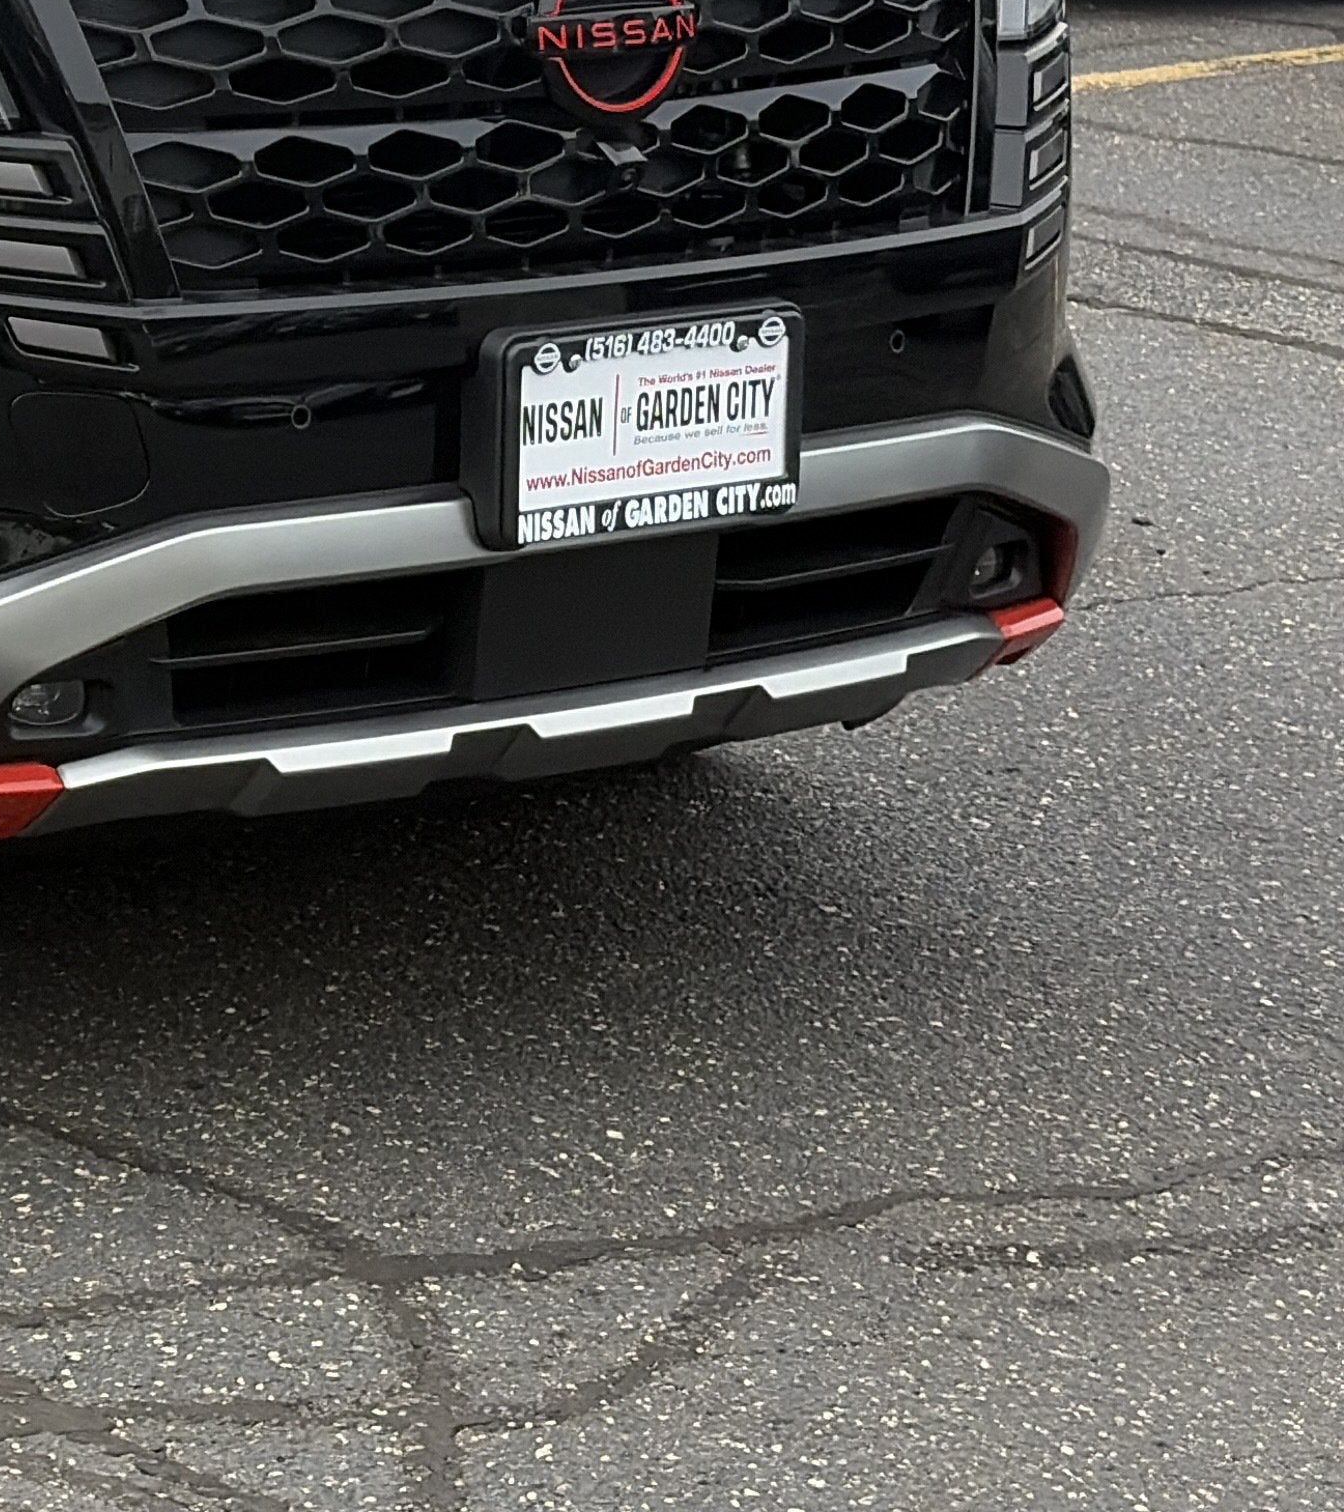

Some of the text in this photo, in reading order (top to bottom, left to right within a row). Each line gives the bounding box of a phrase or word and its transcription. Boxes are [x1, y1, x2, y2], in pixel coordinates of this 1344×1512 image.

[537, 12, 696, 51] NISSAN
[584, 321, 736, 362] (516) 483-4400
[638, 363, 776, 387] The World's #1 Nissan Dealer
[522, 377, 776, 446] NISSAN OF GARDEN CITY
[634, 432, 681, 445] Because
[684, 430, 701, 439] we
[704, 425, 723, 437] sell
[726, 424, 741, 435] for
[526, 449, 771, 492] www.NissanofGardenCity.com
[517, 482, 797, 544] NISSAN of GARDEN CITY.com
